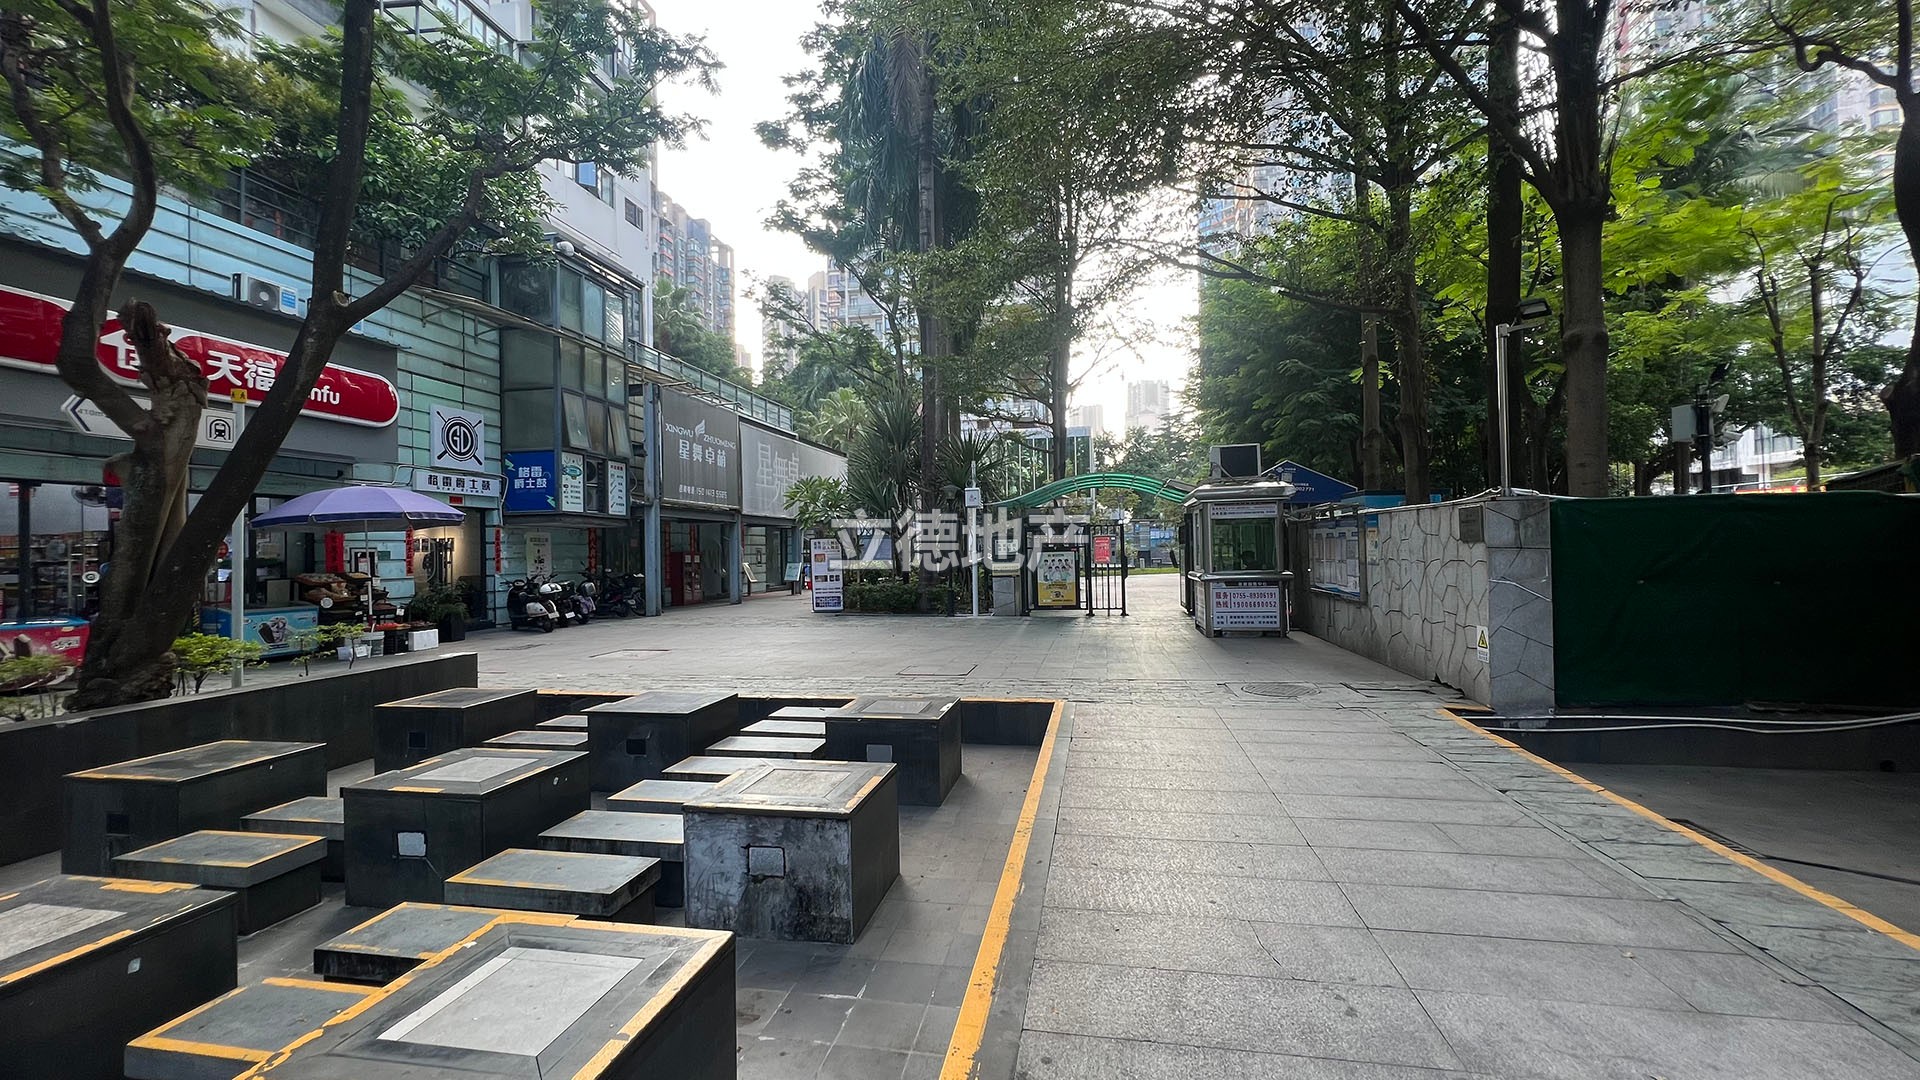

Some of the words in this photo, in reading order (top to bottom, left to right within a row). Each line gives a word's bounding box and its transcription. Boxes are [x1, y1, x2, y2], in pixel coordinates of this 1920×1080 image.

[206, 350, 277, 391] 天福
[308, 385, 340, 405] nfu
[449, 425, 472, 453] GD
[665, 423, 694, 438] XINGWU
[679, 439, 726, 468] 星舞卓萌
[518, 466, 542, 478] 格雷
[514, 478, 547, 489] 爵士鼓
